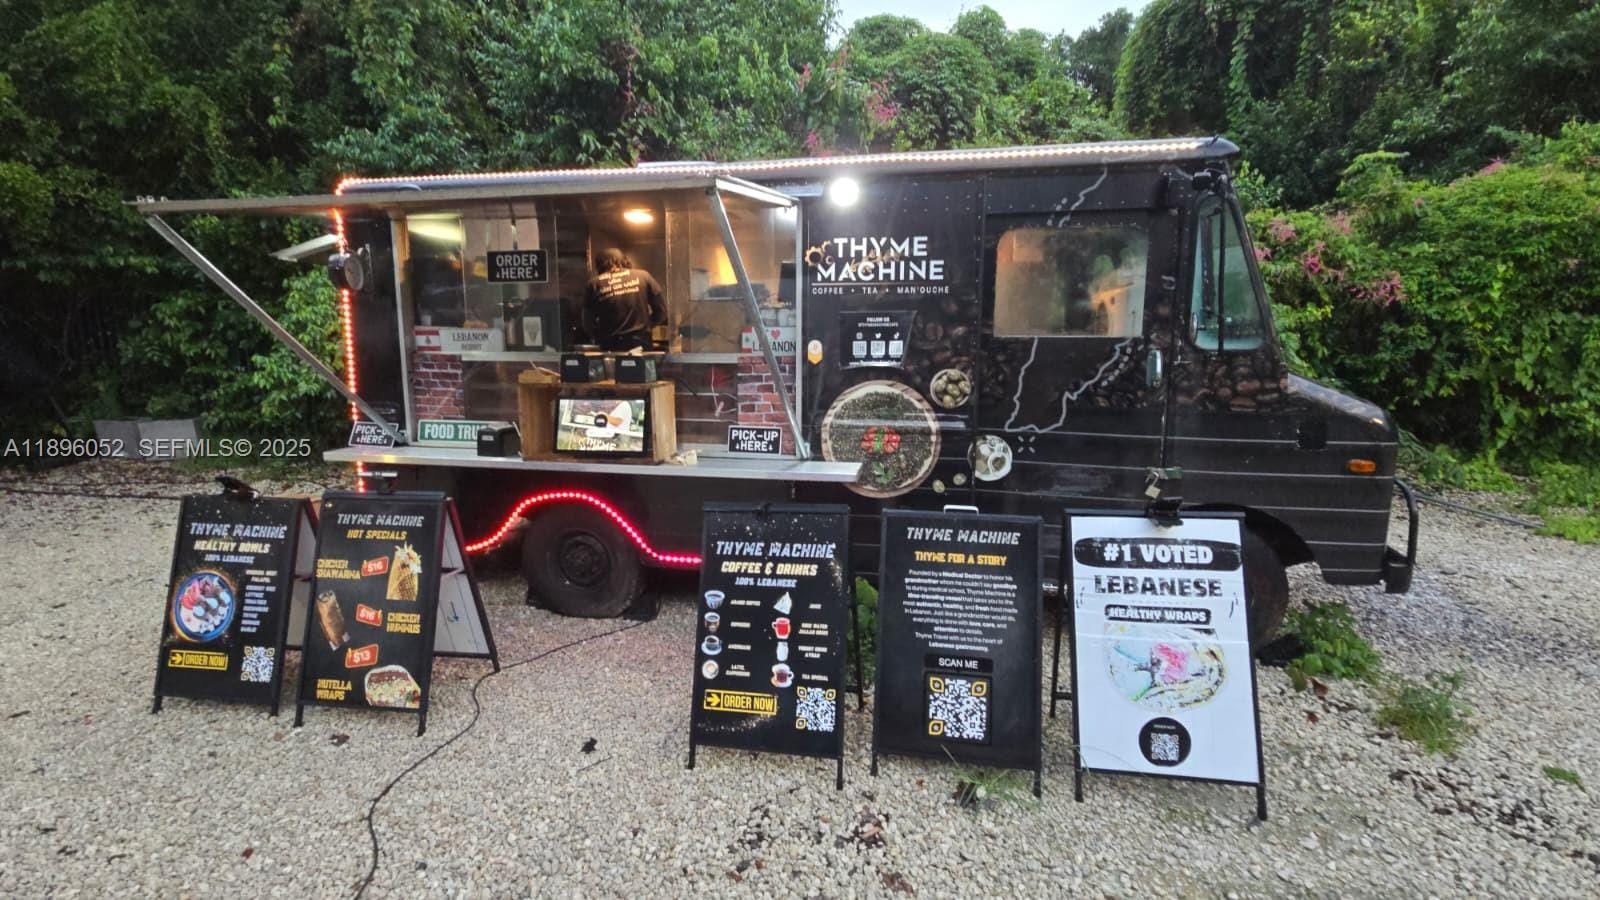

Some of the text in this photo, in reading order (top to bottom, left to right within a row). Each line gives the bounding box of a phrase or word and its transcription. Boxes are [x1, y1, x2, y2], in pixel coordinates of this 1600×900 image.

[833, 236, 928, 258] THYME
[496, 254, 537, 266] ORDER
[501, 267, 532, 279] HERE
[817, 260, 944, 281] MACHINE
[812, 287, 843, 295] COFFEE
[897, 286, 949, 294] MAN'OUCHE
[752, 340, 797, 352] LANON
[424, 424, 488, 440] FOOD TRU
[732, 430, 778, 440] PICK-UP
[360, 435, 384, 444] HERE
[740, 440, 768, 451] HERE
[337, 513, 424, 527] THYME MACHINE
[190, 522, 288, 539] THYME MACHINE
[346, 529, 407, 540] HOT SPECIALS
[907, 527, 1021, 545] THYME MACHINE
[194, 540, 271, 554] HEALTHY BOWLS
[716, 541, 836, 559] THYME MACHINE
[1103, 543, 1214, 564] #1 VOTED
[222, 554, 256, 564] LEBANESE
[914, 550, 1008, 566] THYME FOR A STORY
[317, 559, 384, 572] CHICKEN $16
[721, 561, 818, 576] COFFEE & DRINKS
[316, 569, 360, 580] SHAWARMA
[734, 577, 798, 588] 100% LEBANESE
[1094, 575, 1223, 597] LEBANESE
[388, 612, 420, 622] CHICKEN
[1108, 606, 1206, 622] HEALTHY WRAPS
[386, 622, 421, 634] HUMMUS
[185, 654, 226, 667] ORDER NOW
[353, 650, 370, 663] $13
[938, 657, 978, 670] SCAN ME
[317, 678, 352, 690] NUTELLA
[316, 689, 345, 700] WRAPS
[724, 695, 774, 711] ORDER NOW
